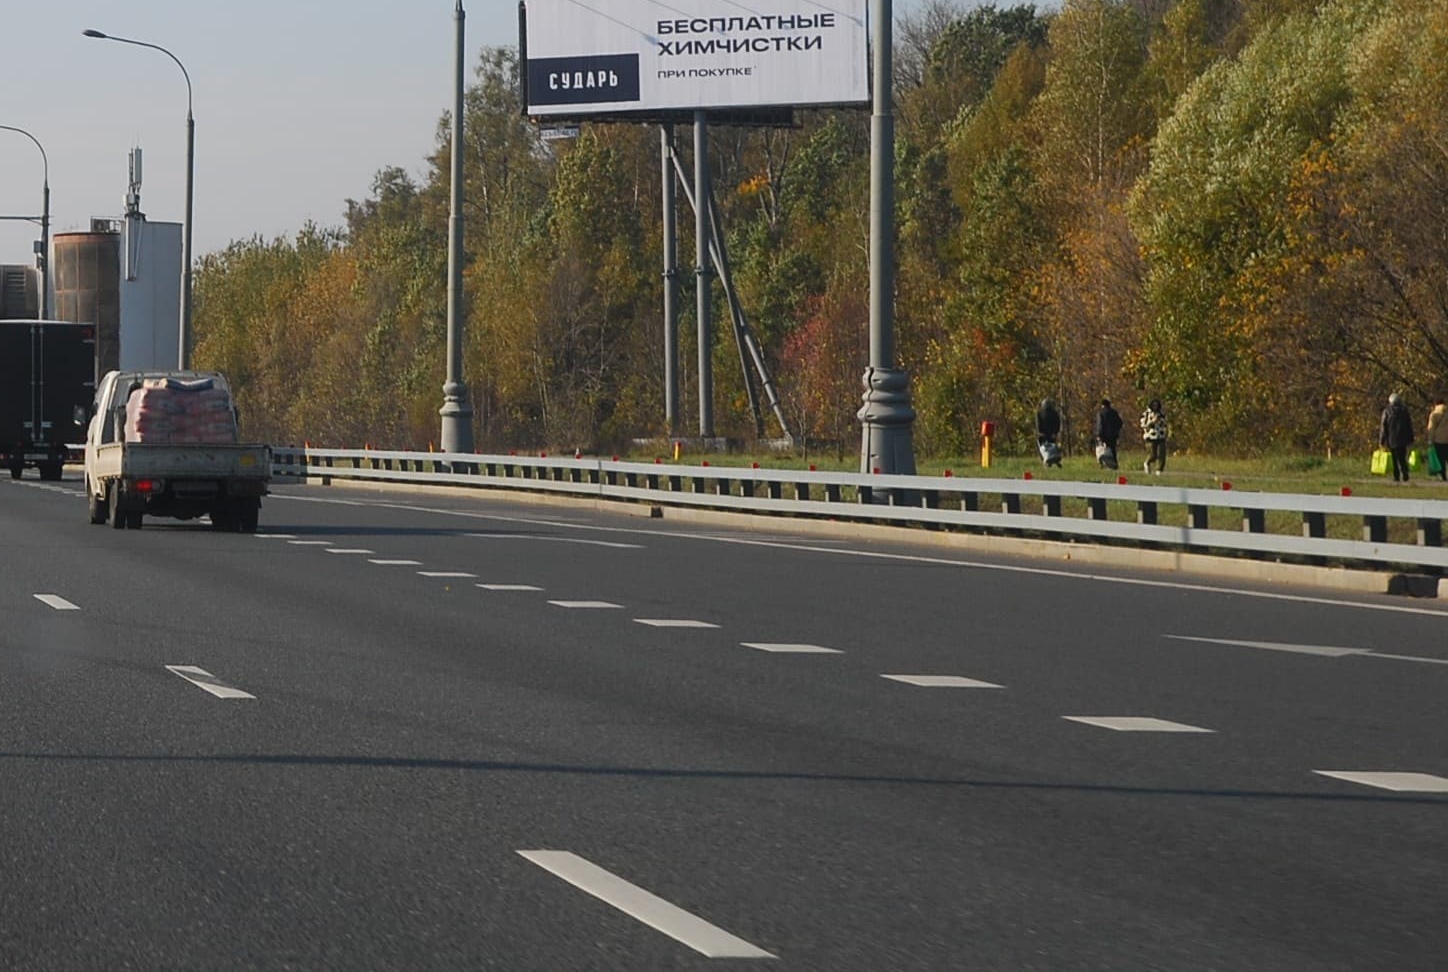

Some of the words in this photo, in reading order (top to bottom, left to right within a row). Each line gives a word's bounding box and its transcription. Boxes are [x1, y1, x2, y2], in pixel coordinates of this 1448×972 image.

[657, 13, 835, 35] БЕСПЛАТНЫЕ
[658, 36, 823, 56] ХИМЧИСТКИ
[549, 70, 618, 90] СУДАРЬ
[657, 70, 686, 79] ПРИ
